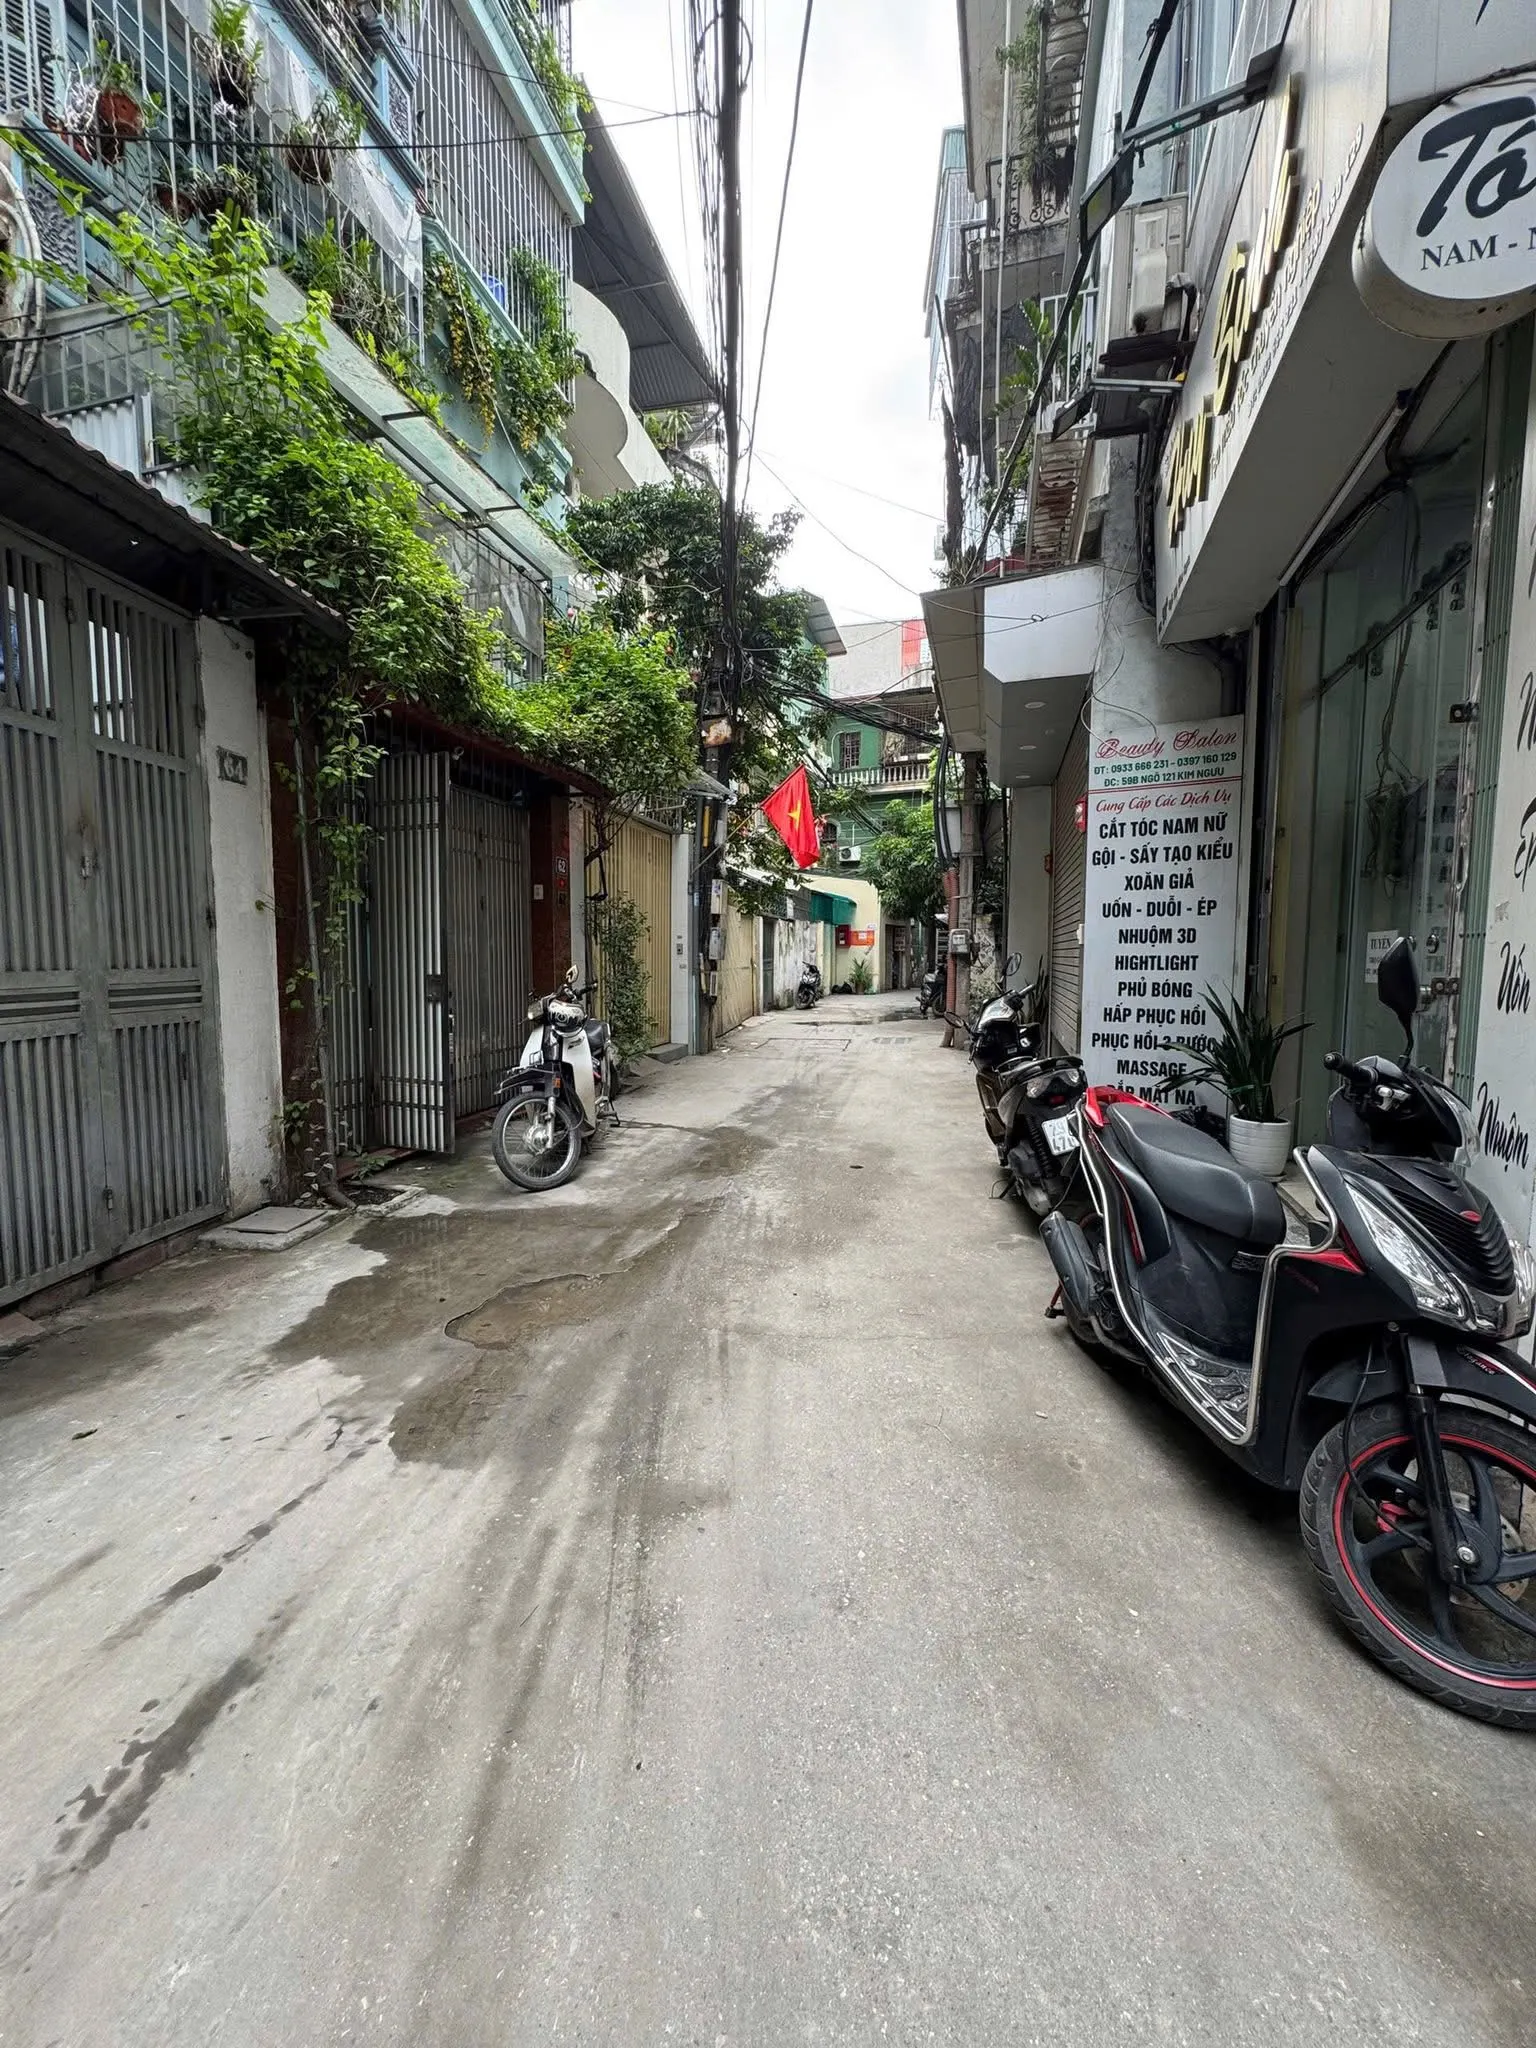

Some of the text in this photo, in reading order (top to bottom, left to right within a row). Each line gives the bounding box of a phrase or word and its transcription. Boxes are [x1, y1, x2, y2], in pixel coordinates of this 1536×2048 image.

[1420, 234, 1498, 271] NAM
[1095, 728, 1237, 759] Beauty Salon
[1111, 763, 1133, 773] 0933
[1135, 761, 1152, 771] 666
[1154, 759, 1169, 769] 231
[1177, 756, 1200, 767] 0397
[1203, 754, 1219, 764] 160
[1221, 751, 1237, 762] 129
[1121, 775, 1139, 786] 59B
[1162, 771, 1176, 782] 121
[1178, 770, 1195, 781] KIM
[1096, 789, 1231, 814] Cung Cấp Các Dịch Vụ
[1099, 812, 1228, 839] CẮT TÓC NAM NỮ
[1092, 847, 1115, 868] GỘI
[1130, 842, 1159, 864] SẤY
[1163, 845, 1191, 866] TẠO
[1197, 836, 1233, 859] KIỂU
[1124, 868, 1194, 891] XOĂN GIẢ
[1102, 897, 1131, 918] UỐN
[1147, 896, 1181, 917] DUỖI
[1197, 897, 1217, 916] ÉP
[1119, 926, 1197, 947] NHUỘM 3D
[1115, 955, 1199, 971] HIGHTLIGHT
[1118, 977, 1192, 998] PHỦ BÓNG
[1497, 942, 1530, 1015] Uốn
[1103, 1003, 1206, 1027] HẤP PHỤC HỒI
[1092, 1033, 1129, 1051] PHỤC
[1134, 1030, 1158, 1050] HỒI
[1117, 1060, 1187, 1077] MASSAGE
[1175, 1089, 1196, 1109] NẠ
[1477, 1081, 1530, 1172] Nhuộm
